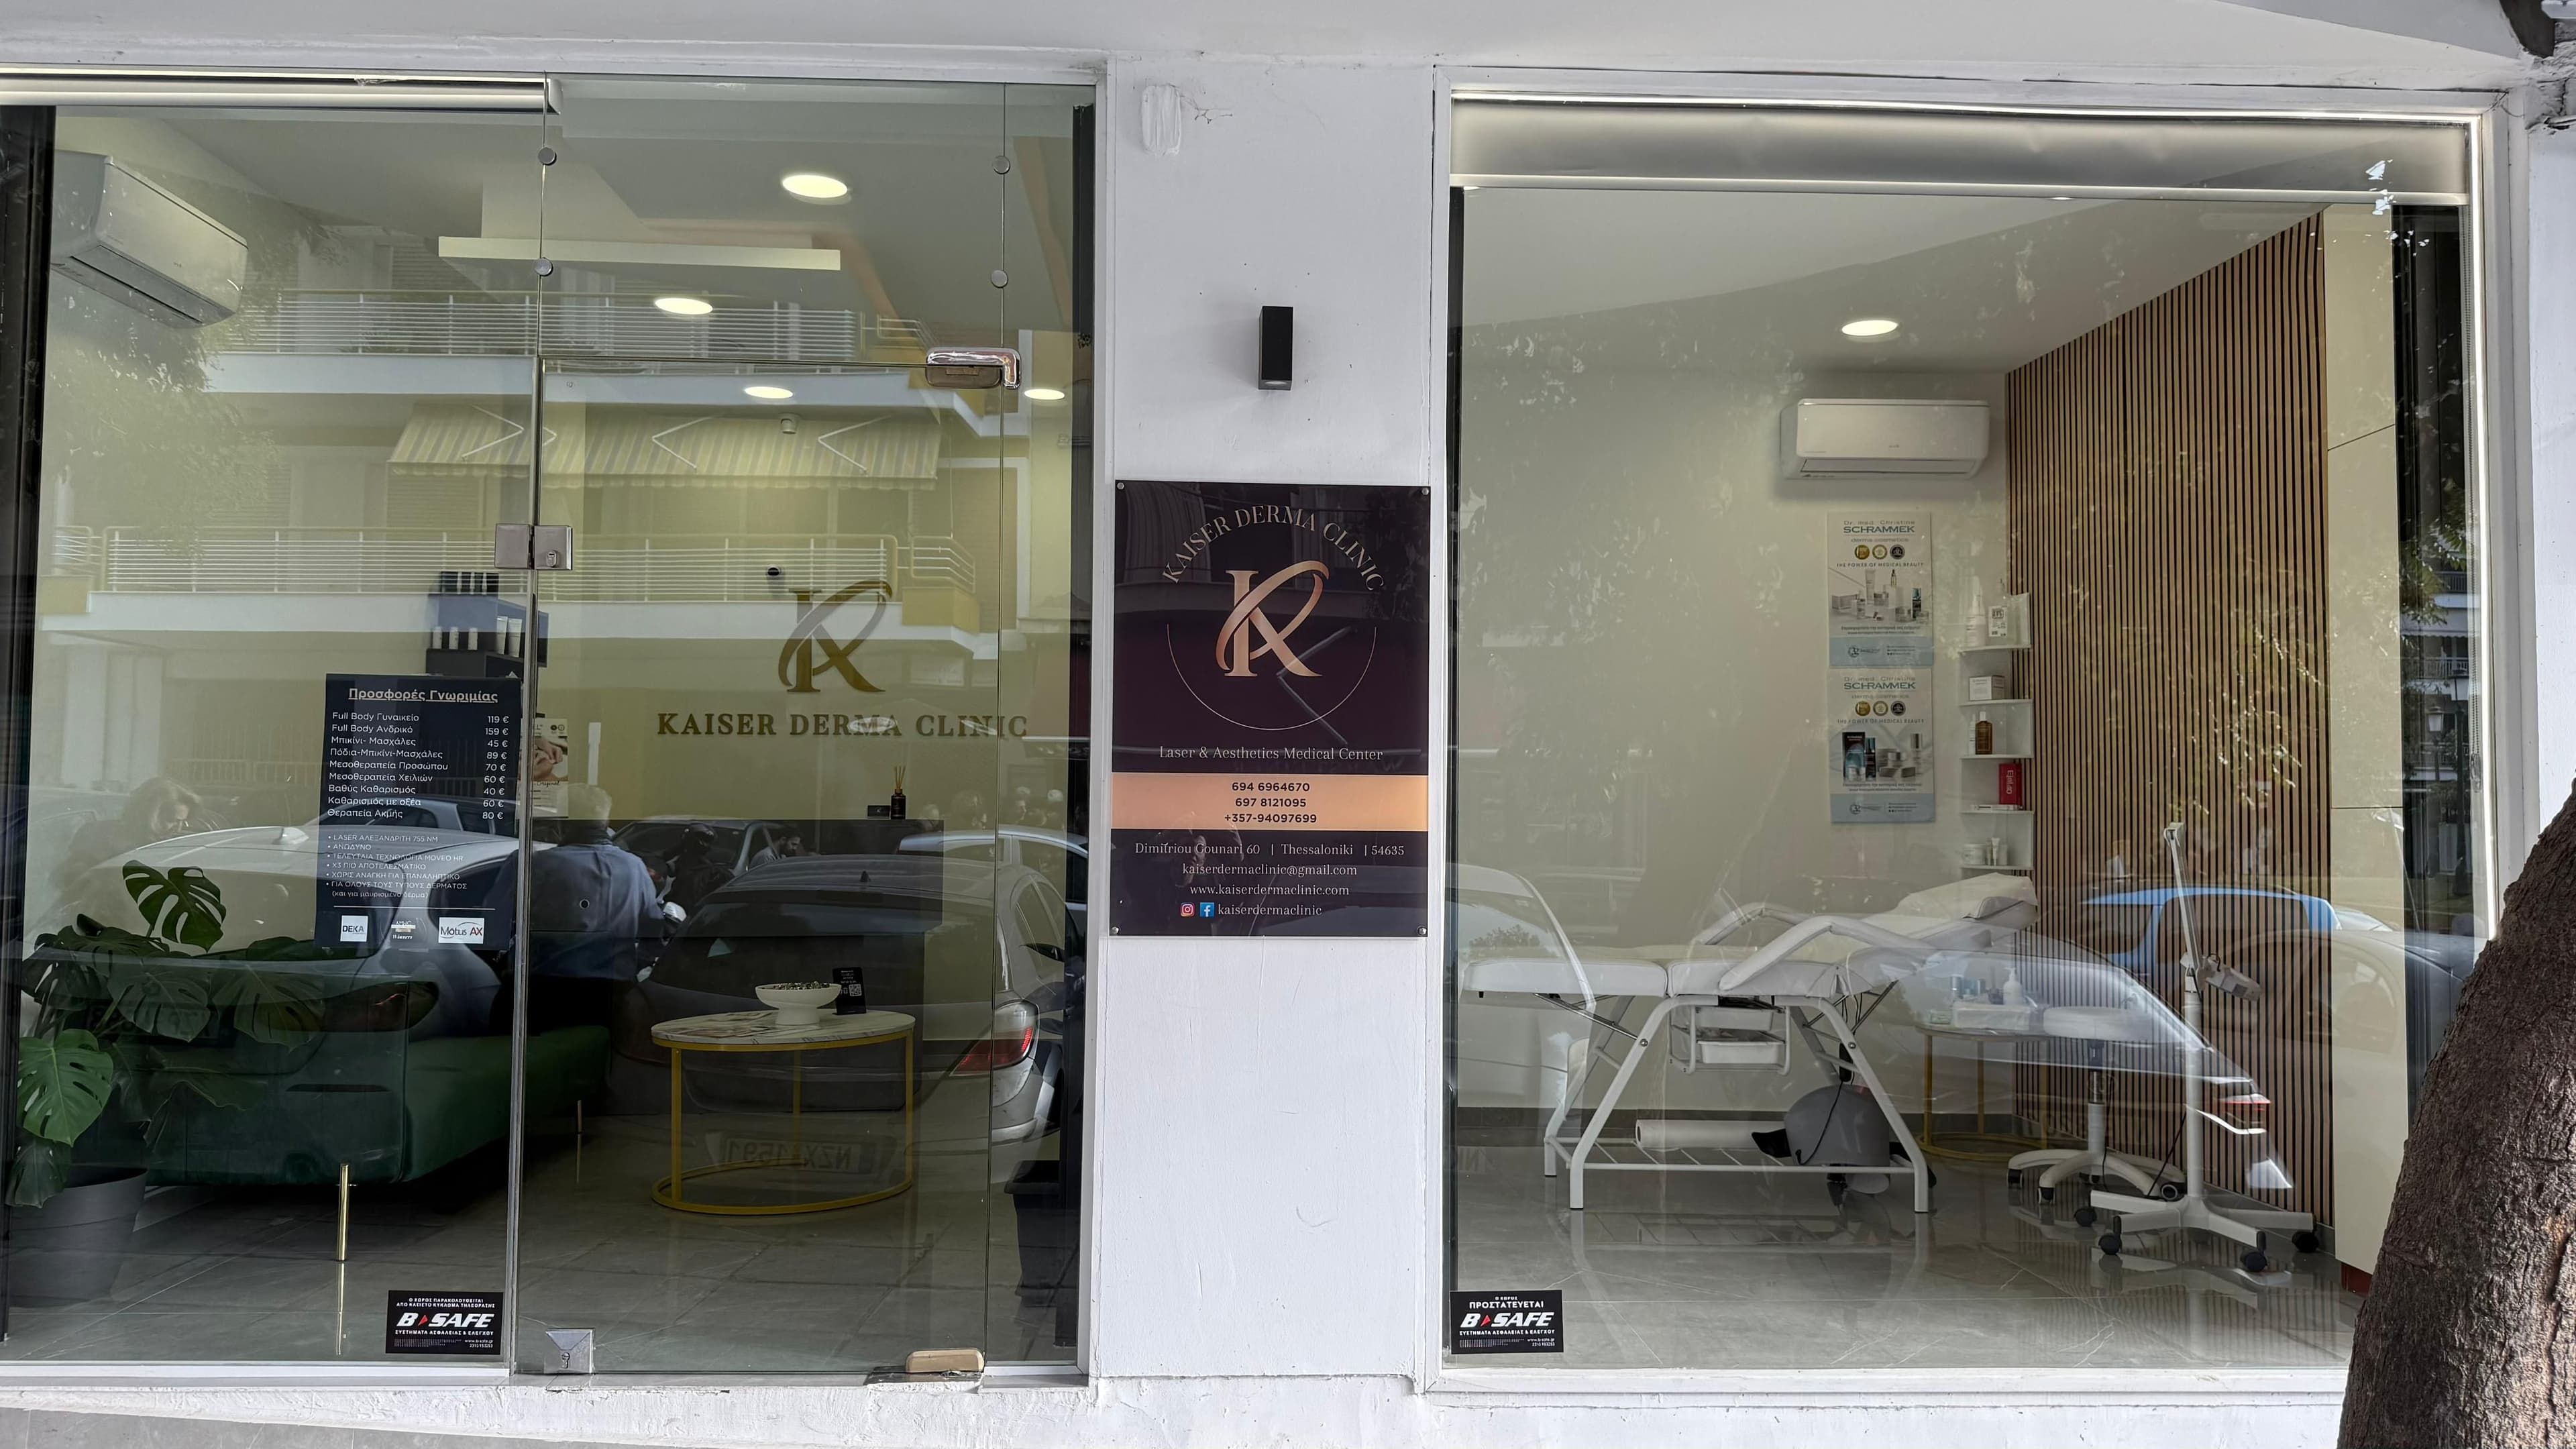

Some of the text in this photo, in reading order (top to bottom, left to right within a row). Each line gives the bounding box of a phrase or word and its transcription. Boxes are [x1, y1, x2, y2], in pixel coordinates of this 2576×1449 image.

[1843, 525, 1915, 533] SCHRAMMEK
[1161, 504, 1385, 592] KAISER DERMA CLINIC
[349, 688, 498, 702] Προσφορές Γνωριμίας
[351, 712, 374, 721] Body
[377, 712, 419, 721] Γυναικείο
[350, 724, 373, 733] Body
[376, 725, 413, 734] Ανδρικό
[657, 712, 1028, 738] KAISER DERMA CLINIC
[331, 736, 366, 744] Μπικίνι-
[370, 737, 416, 747] Μασχάλες
[330, 748, 443, 759] Πόδια-Μπικίνι-Μασχάλες
[1159, 746, 1383, 761] Laser & Aesthetics Medical Center
[329, 761, 396, 771] Μεσοθεραπεία
[399, 761, 448, 771] Προσώπου
[329, 773, 396, 782] Μεσοθεραπεία
[398, 773, 433, 782] Χειλιών
[329, 785, 358, 794] Βαθύς
[360, 786, 416, 795] Καθαρισμός
[1232, 782, 1310, 792] 694 6964670
[328, 797, 384, 806] Καθαρισμός
[400, 798, 421, 807] οξέα
[1235, 797, 1307, 808] 697 8121095
[327, 810, 372, 819] Θεραπεία
[374, 810, 402, 819] Ακμής
[1224, 813, 1318, 824] +357-94097699
[1135, 842, 1191, 855] Dimitriou
[1195, 843, 1243, 855] Gounari
[1246, 844, 1260, 855] 60
[1281, 843, 1353, 855] Thessaloniki
[1371, 845, 1405, 857] 54635
[1182, 864, 1358, 878] kaiserdermaclinic@gmail.com
[1190, 885, 1350, 897] www.kaiserdermaclinic.com
[1218, 904, 1322, 916] kaiserdermaclinic
[441, 926, 482, 936] Motus AX
[1469, 1301, 1544, 1309] ΠΡΟΣΤΑΤΕΥΕΤΑΙ
